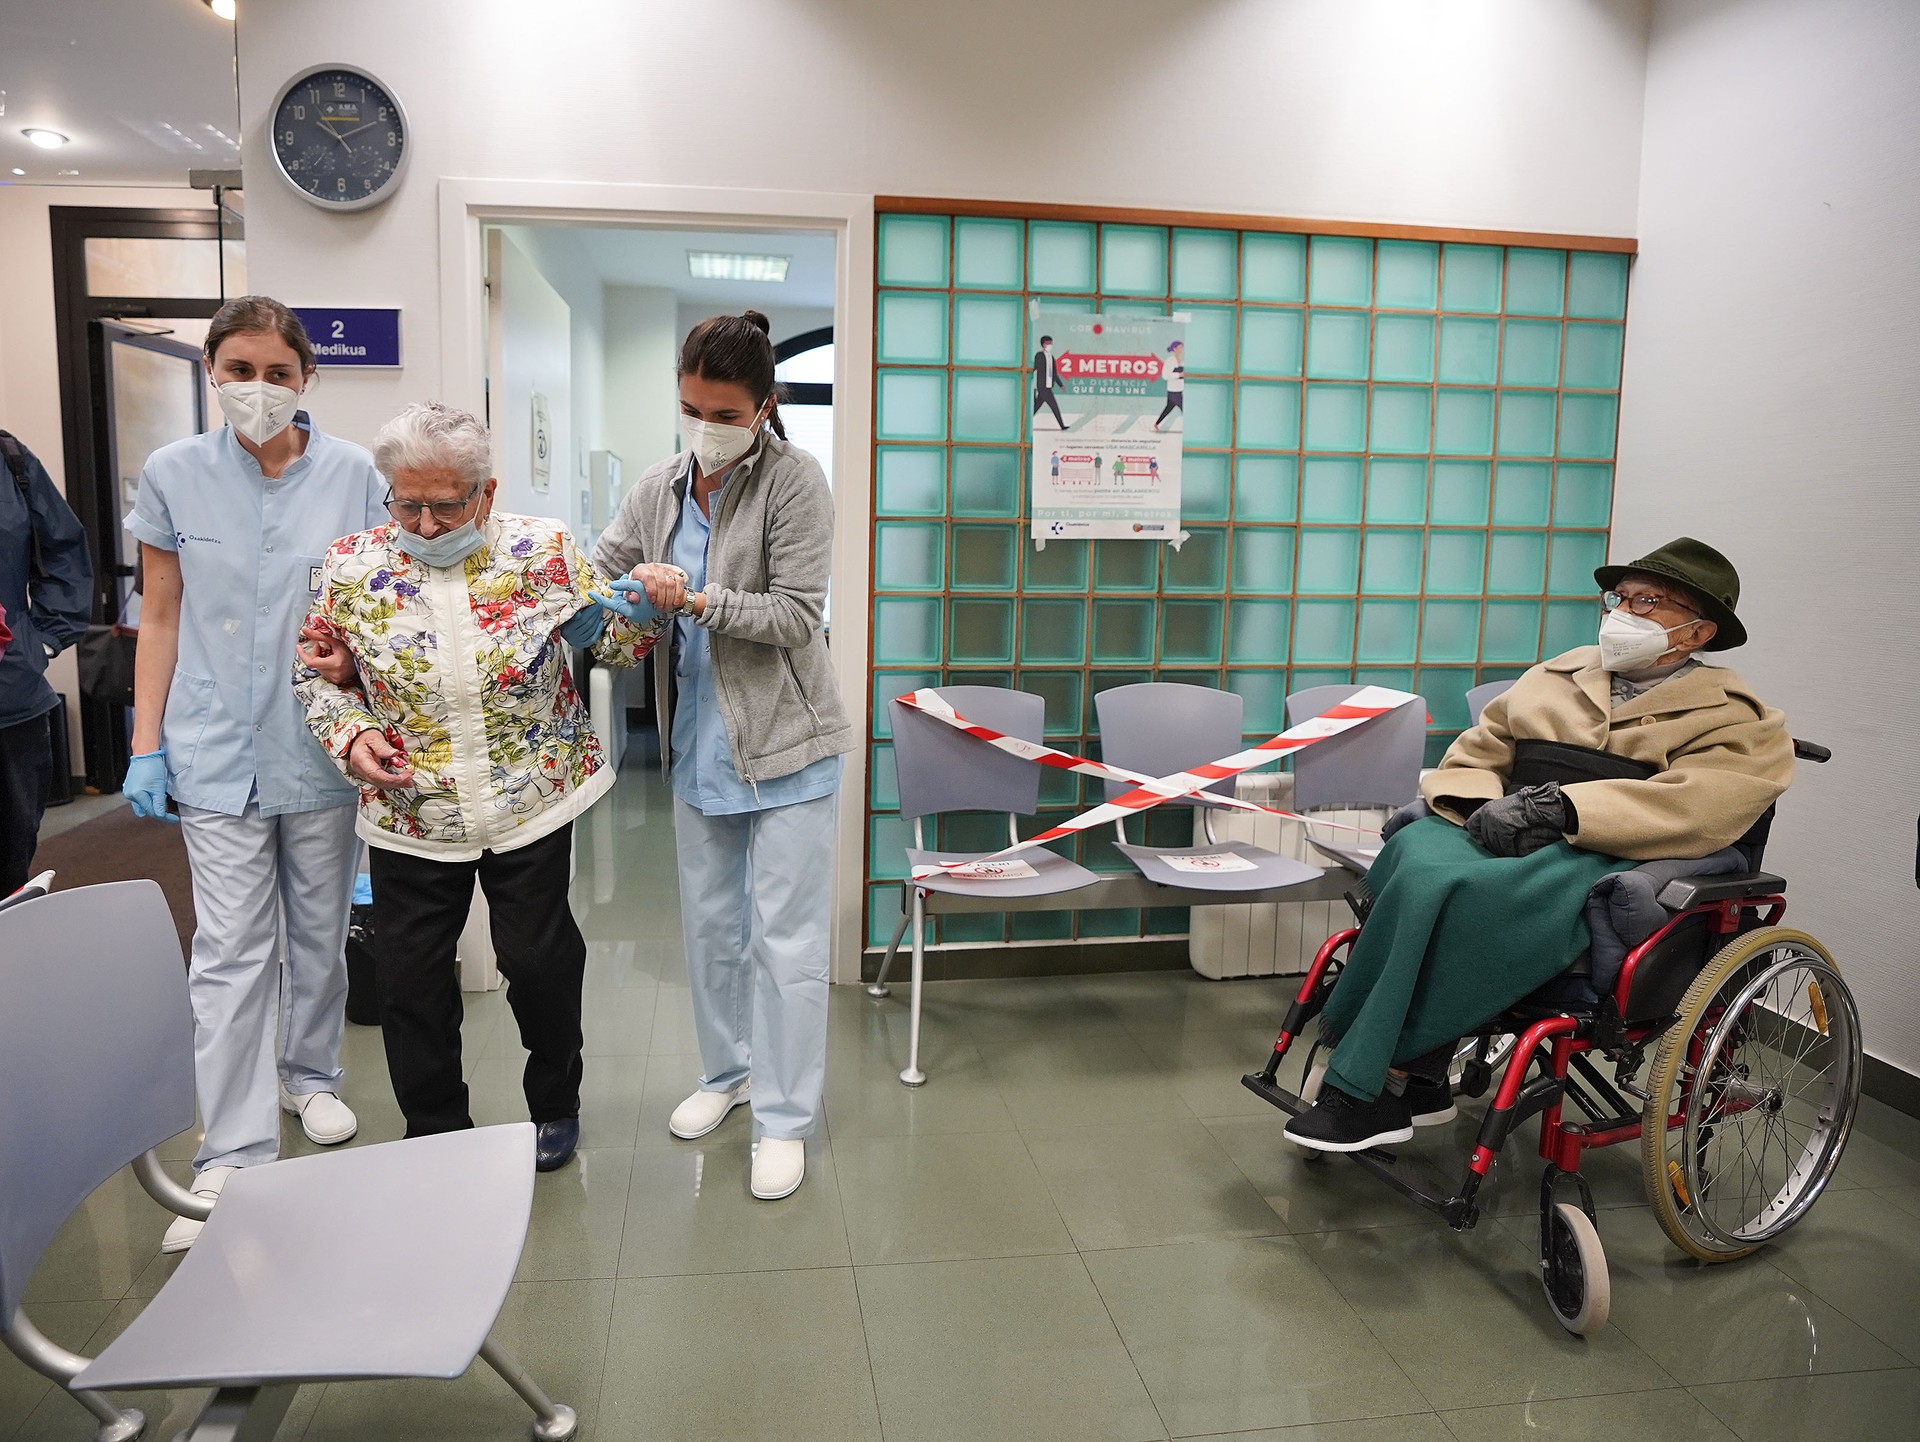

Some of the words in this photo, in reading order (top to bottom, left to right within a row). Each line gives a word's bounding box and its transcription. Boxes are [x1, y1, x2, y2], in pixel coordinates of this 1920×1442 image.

[309, 89, 320, 105] 11
[332, 82, 346, 98] 12
[361, 89, 365, 104] 1
[292, 105, 306, 121] 10
[378, 106, 388, 122] 2
[285, 131, 294, 146] 9
[387, 131, 396, 147] 3
[292, 160, 299, 170] 8
[383, 160, 390, 171] 4
[312, 178, 319, 189] 7
[337, 178, 346, 193] 6
[331, 320, 345, 338] 2
[1060, 358, 1072, 373] 2
[1079, 359, 1159, 374] METROS
[1073, 386, 1095, 394] QUE
[1089, 379, 1148, 387] DISTANCIA
